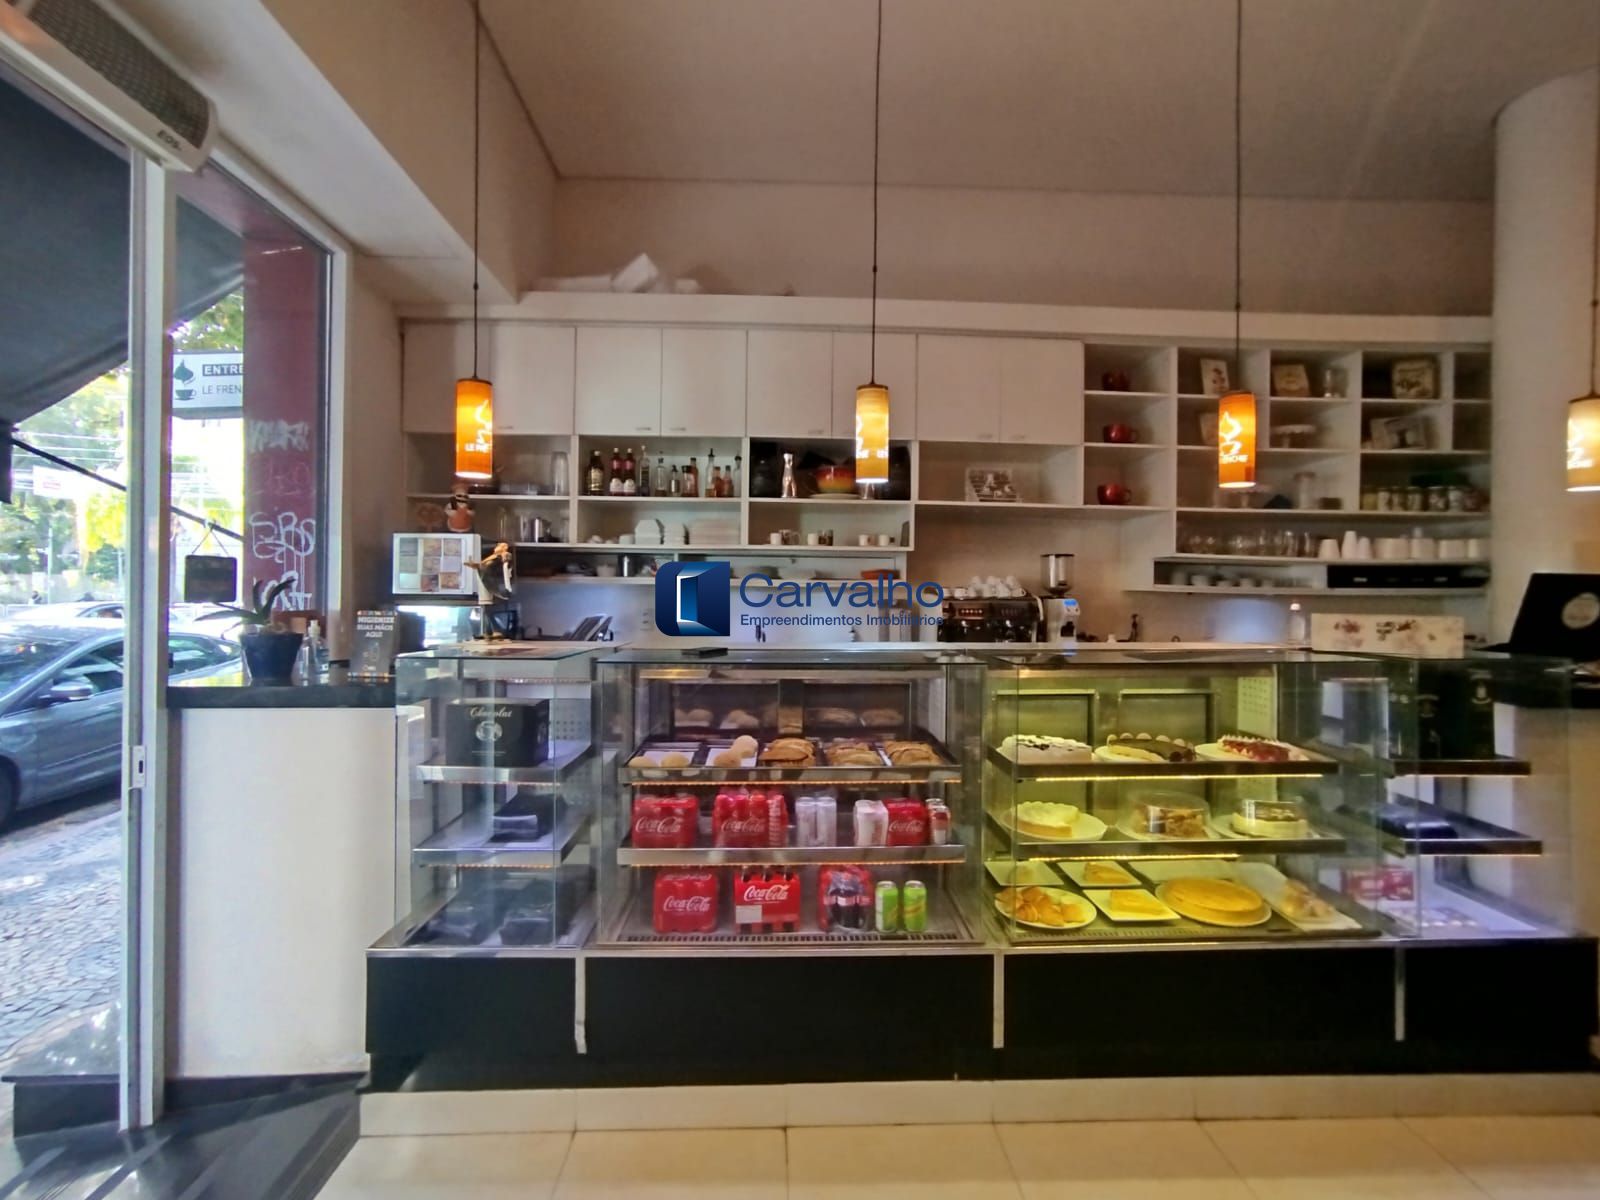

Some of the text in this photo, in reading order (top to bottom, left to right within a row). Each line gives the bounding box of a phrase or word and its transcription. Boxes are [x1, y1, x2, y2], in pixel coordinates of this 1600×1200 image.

[202, 385, 213, 395] LE
[744, 884, 790, 902] Coca-Cola
[663, 895, 712, 912] Coca-Cola
